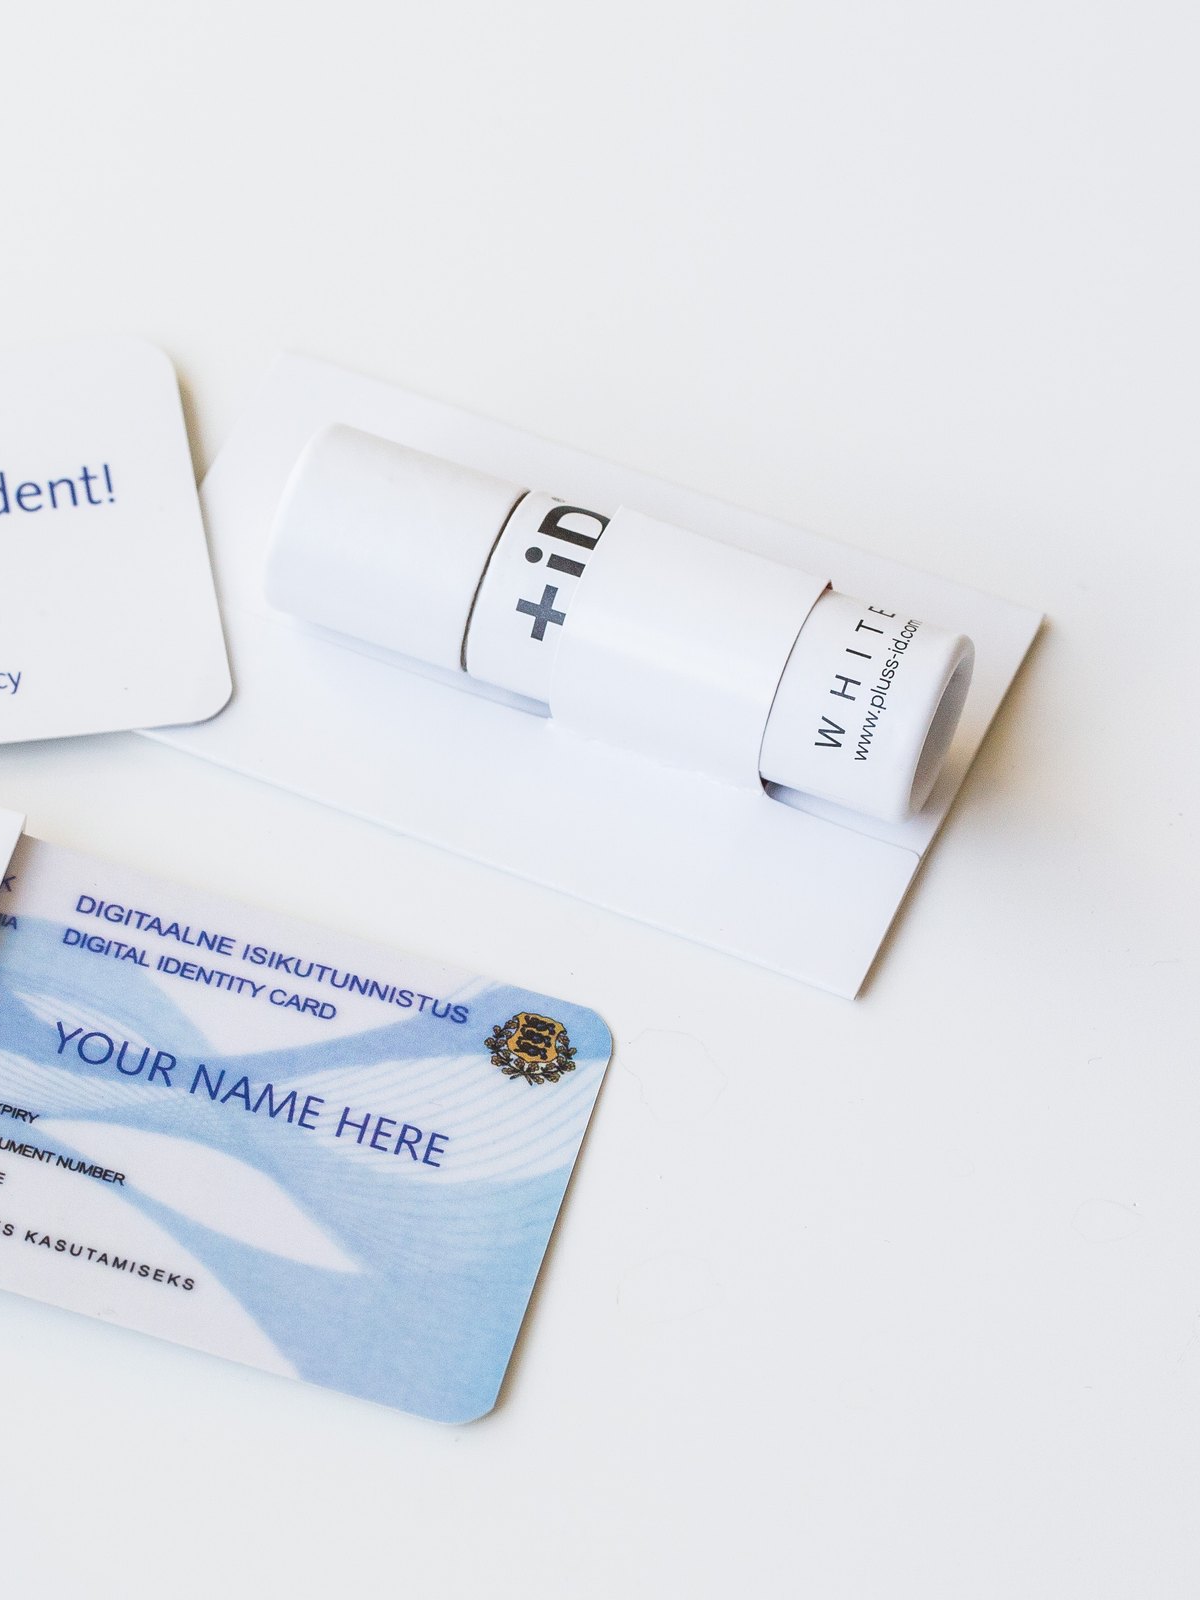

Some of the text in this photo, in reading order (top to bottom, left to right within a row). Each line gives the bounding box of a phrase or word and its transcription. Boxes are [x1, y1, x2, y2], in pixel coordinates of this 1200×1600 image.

[854, 619, 923, 761] www.pluss-id.com
[62, 927, 337, 1020] DIGITAL IDENTITY CARD
[75, 894, 473, 1026] DIGITAALNE ISIKUTUNNISTUS
[56, 1021, 451, 1168] YOUR NAME HERE
[55, 1154, 126, 1187] NUMBER
[24, 1230, 196, 1291] KASUTAMISEKS
